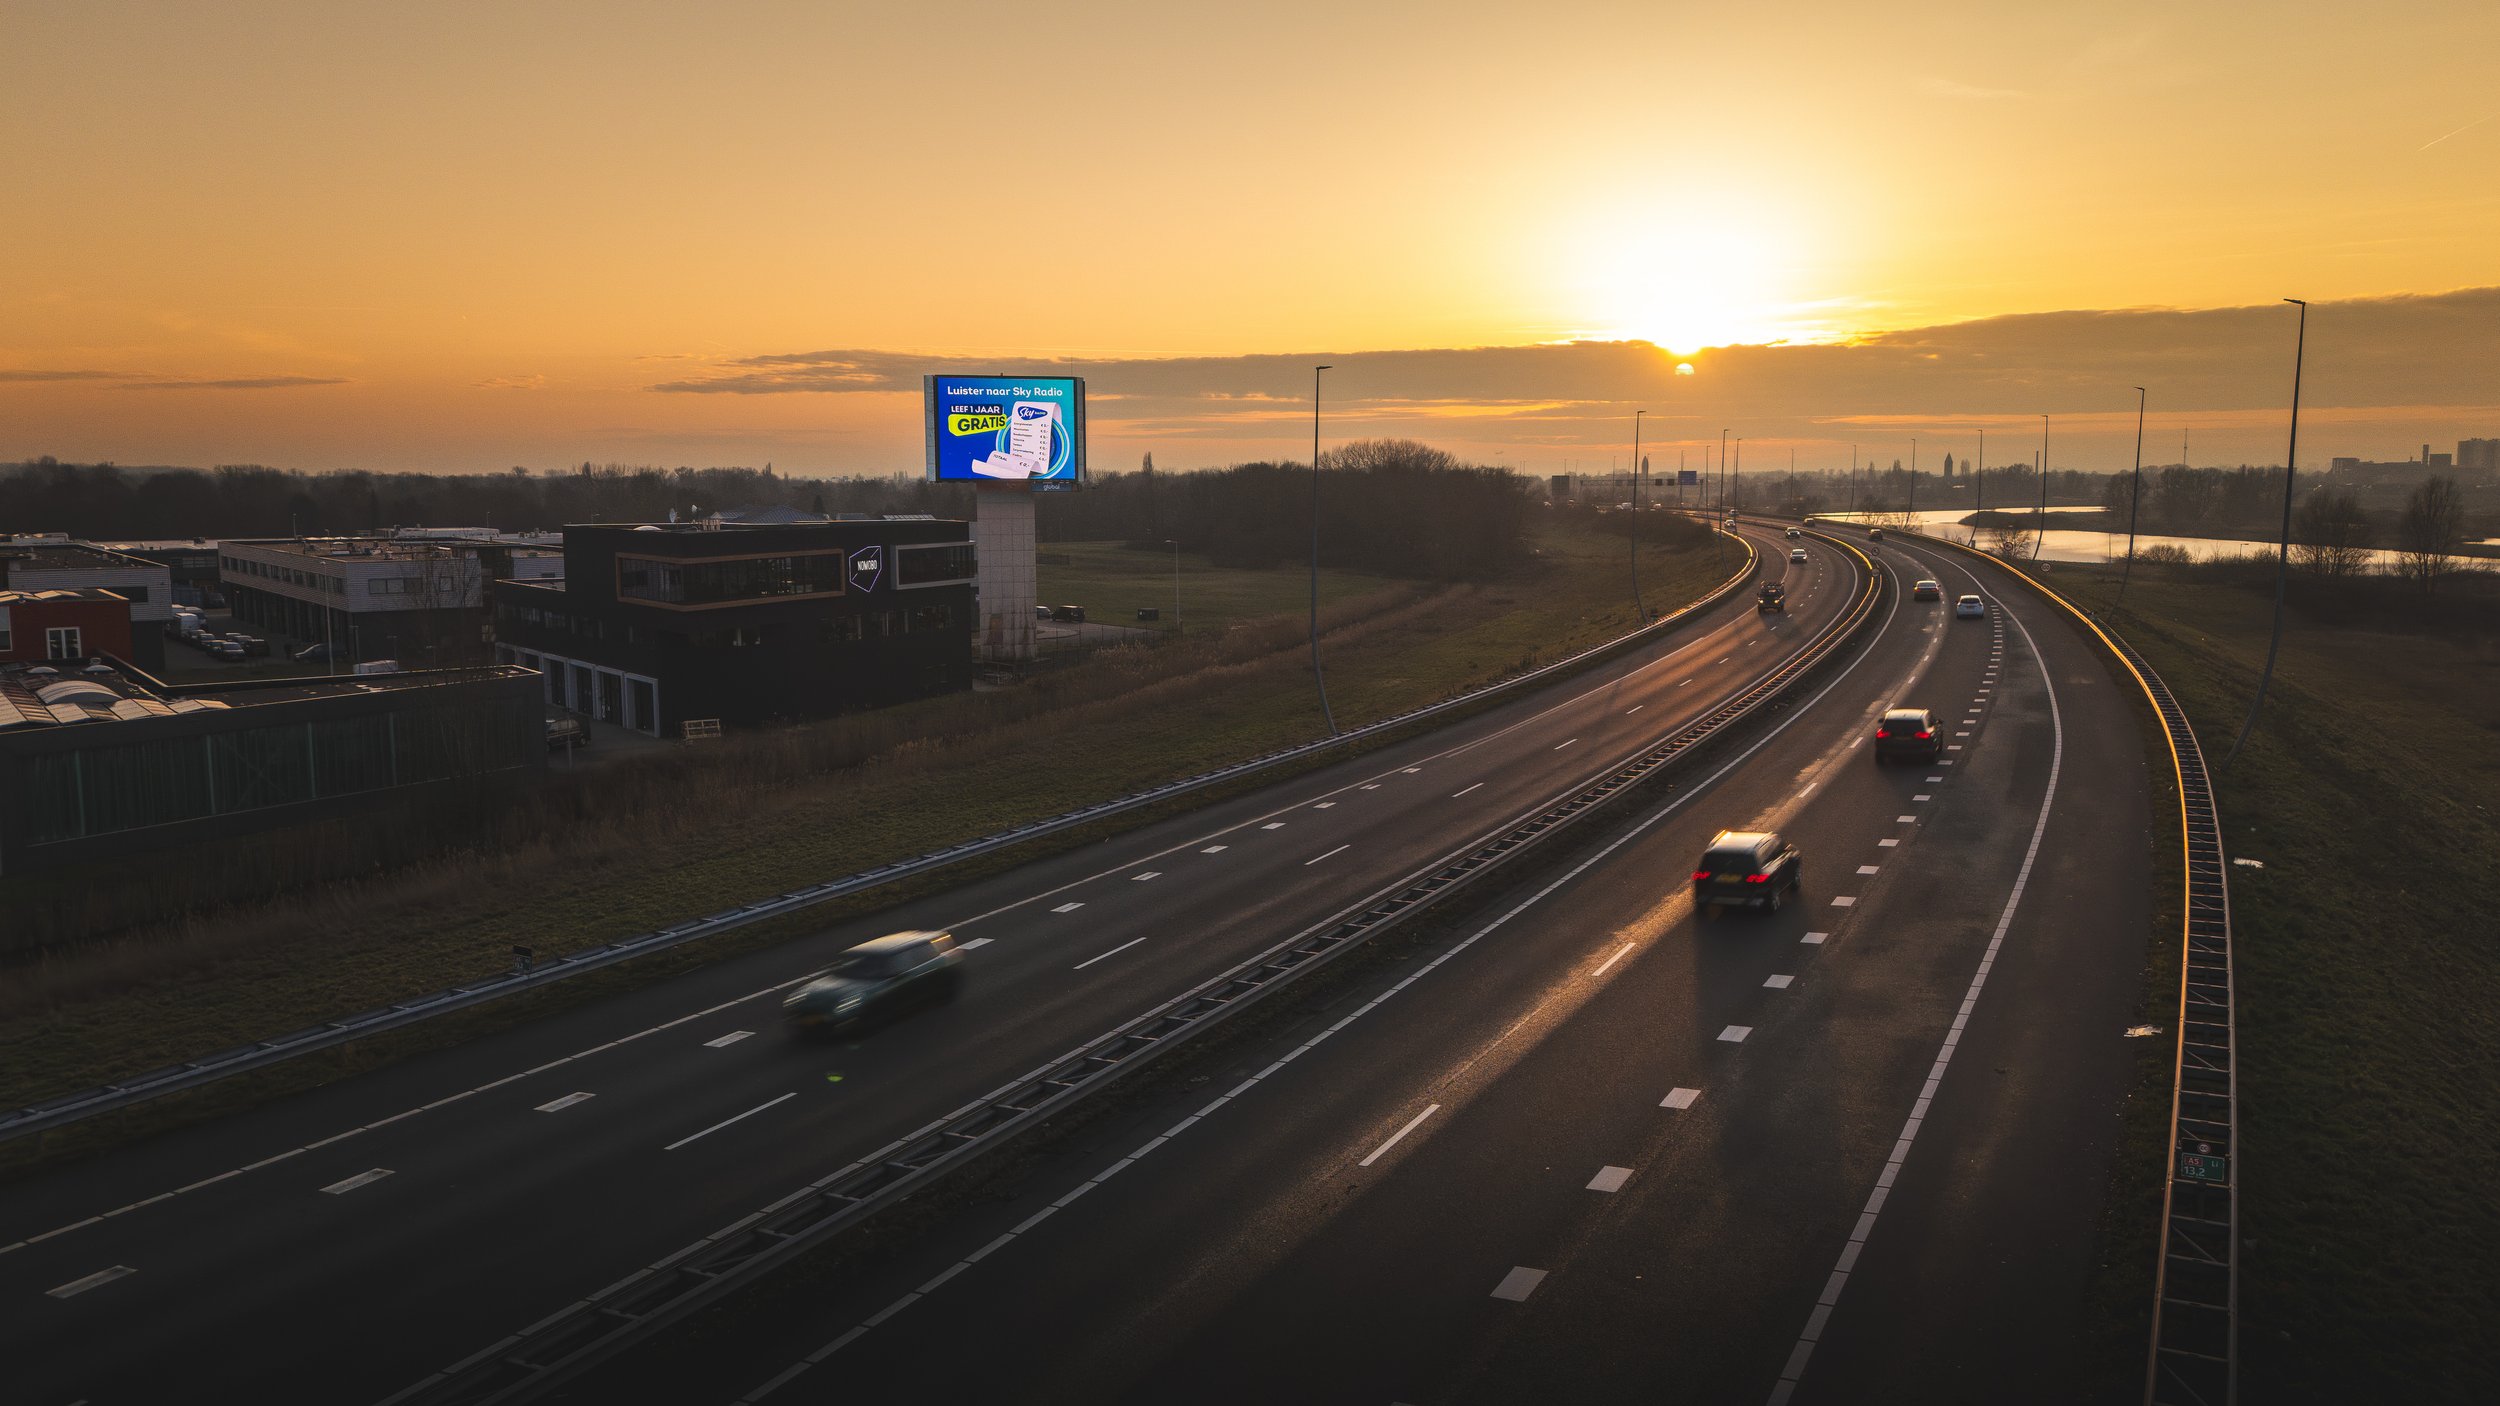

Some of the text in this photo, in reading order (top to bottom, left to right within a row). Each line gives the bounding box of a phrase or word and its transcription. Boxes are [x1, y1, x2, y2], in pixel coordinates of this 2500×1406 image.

[947, 386, 1063, 398] Luister naar Sky Radio
[951, 405, 969, 413] LEEF
[975, 405, 1000, 413] JAAR
[1019, 407, 1035, 419] Sky
[957, 416, 1005, 432] GRATIS
[857, 560, 878, 571] NOMOBO
